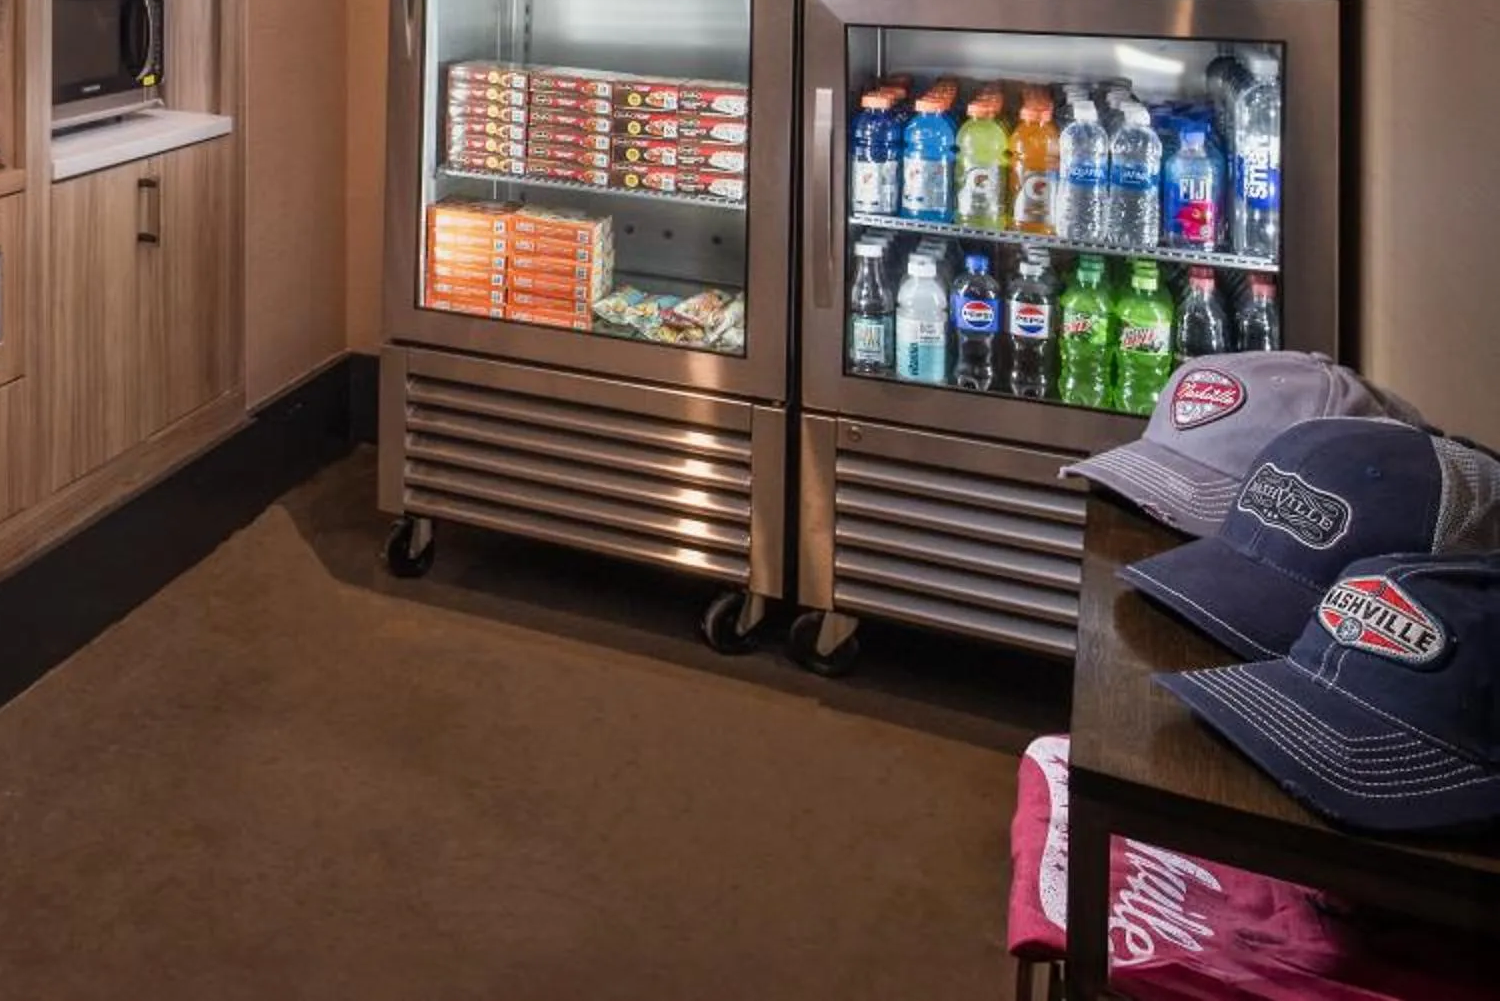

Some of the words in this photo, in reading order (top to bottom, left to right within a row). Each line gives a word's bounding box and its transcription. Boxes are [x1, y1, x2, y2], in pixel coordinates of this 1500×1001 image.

[1179, 178, 1213, 201] FIJI
[1246, 135, 1269, 200] smart
[1249, 481, 1335, 532] NASHVILLE
[1325, 589, 1438, 653] NASHVILLE
